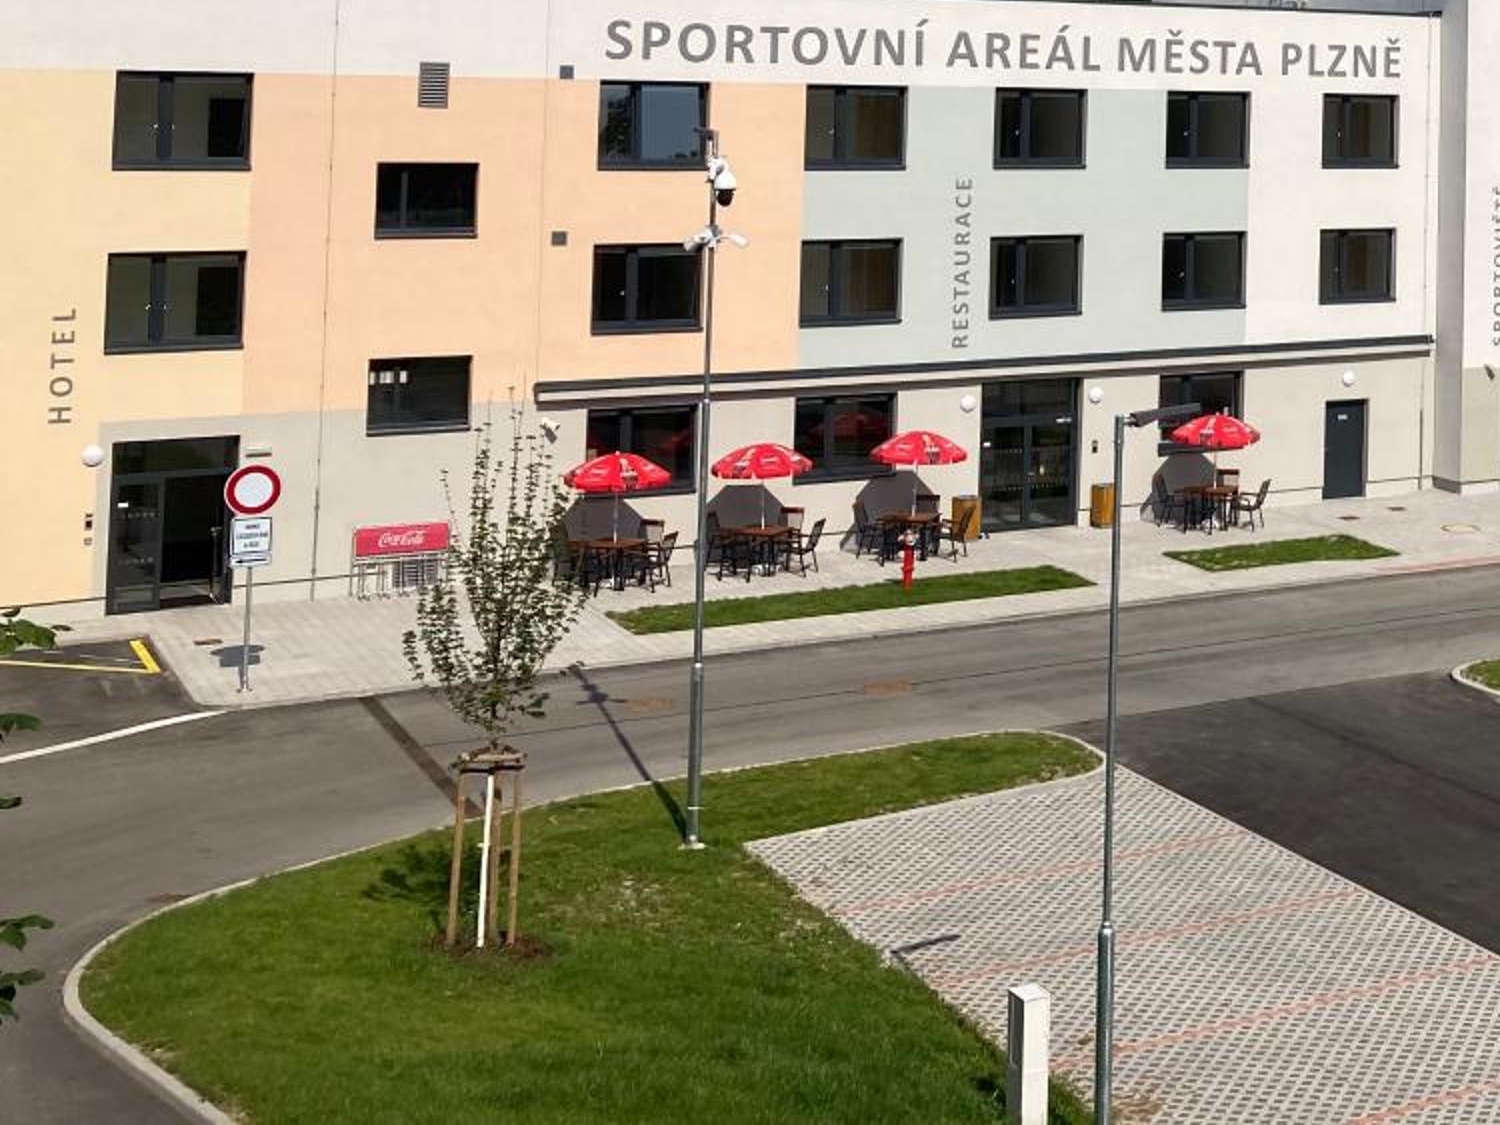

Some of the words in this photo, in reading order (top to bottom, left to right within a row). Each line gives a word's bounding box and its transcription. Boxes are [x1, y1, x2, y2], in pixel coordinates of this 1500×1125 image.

[605, 18, 929, 67] SPORTOVNÍ
[946, 24, 1101, 72] AREÁL
[1117, 29, 1263, 76] MĚSTA
[1281, 38, 1401, 78] PLZNĚ
[951, 178, 973, 349] RESTAURACE
[48, 308, 76, 424] HOTEL
